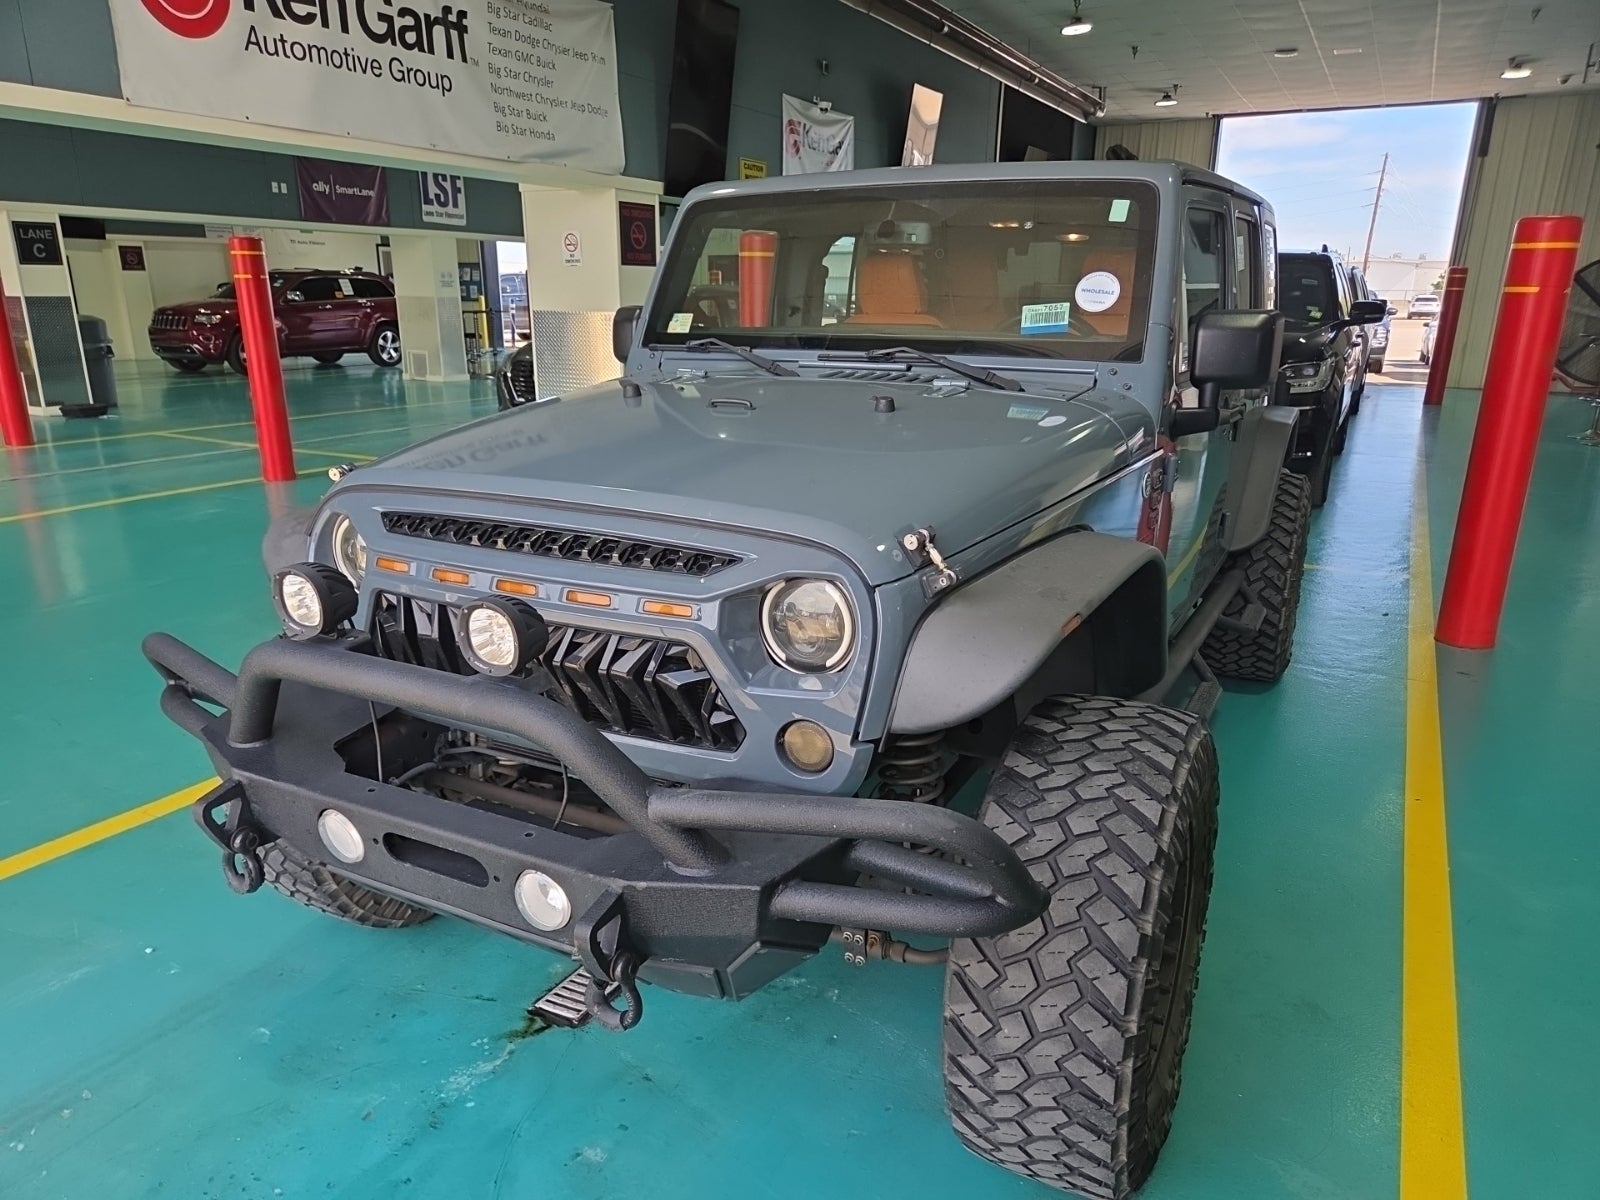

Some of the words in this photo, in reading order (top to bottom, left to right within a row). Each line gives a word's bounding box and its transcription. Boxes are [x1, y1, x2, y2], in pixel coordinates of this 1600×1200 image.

[487, 1, 501, 19] Big
[503, 6, 520, 21] Star
[522, 12, 552, 32] Cadillac
[355, 0, 469, 64] Garff
[487, 22, 512, 39] Texan
[514, 29, 540, 49] Dodge
[571, 47, 589, 62] Jeep
[245, 24, 382, 78] Automotive
[388, 57, 453, 97] Group
[487, 42, 513, 59] Texan
[514, 49, 535, 65] GMC
[536, 55, 557, 71] Buick
[488, 62, 501, 79] Big
[503, 66, 521, 80] Star
[523, 71, 554, 88] Chrysler
[490, 82, 534, 103] Northwest
[535, 92, 568, 109] Chrysler
[570, 100, 586, 113] Jeep
[493, 101, 507, 117] Big
[508, 104, 524, 118] Star
[525, 108, 548, 122] Buick
[496, 121, 509, 137] Big
[511, 123, 527, 137] Star
[529, 127, 556, 141] Honda
[743, 162, 763, 173] CAUTION
[312, 180, 330, 195] ally
[335, 184, 376, 197] SmartLane
[421, 171, 462, 209] LSF
[20, 228, 53, 239] LANE
[33, 243, 46, 258] C
[1081, 288, 1115, 296] WHOLESALE
[1043, 303, 1064, 312] 7057
